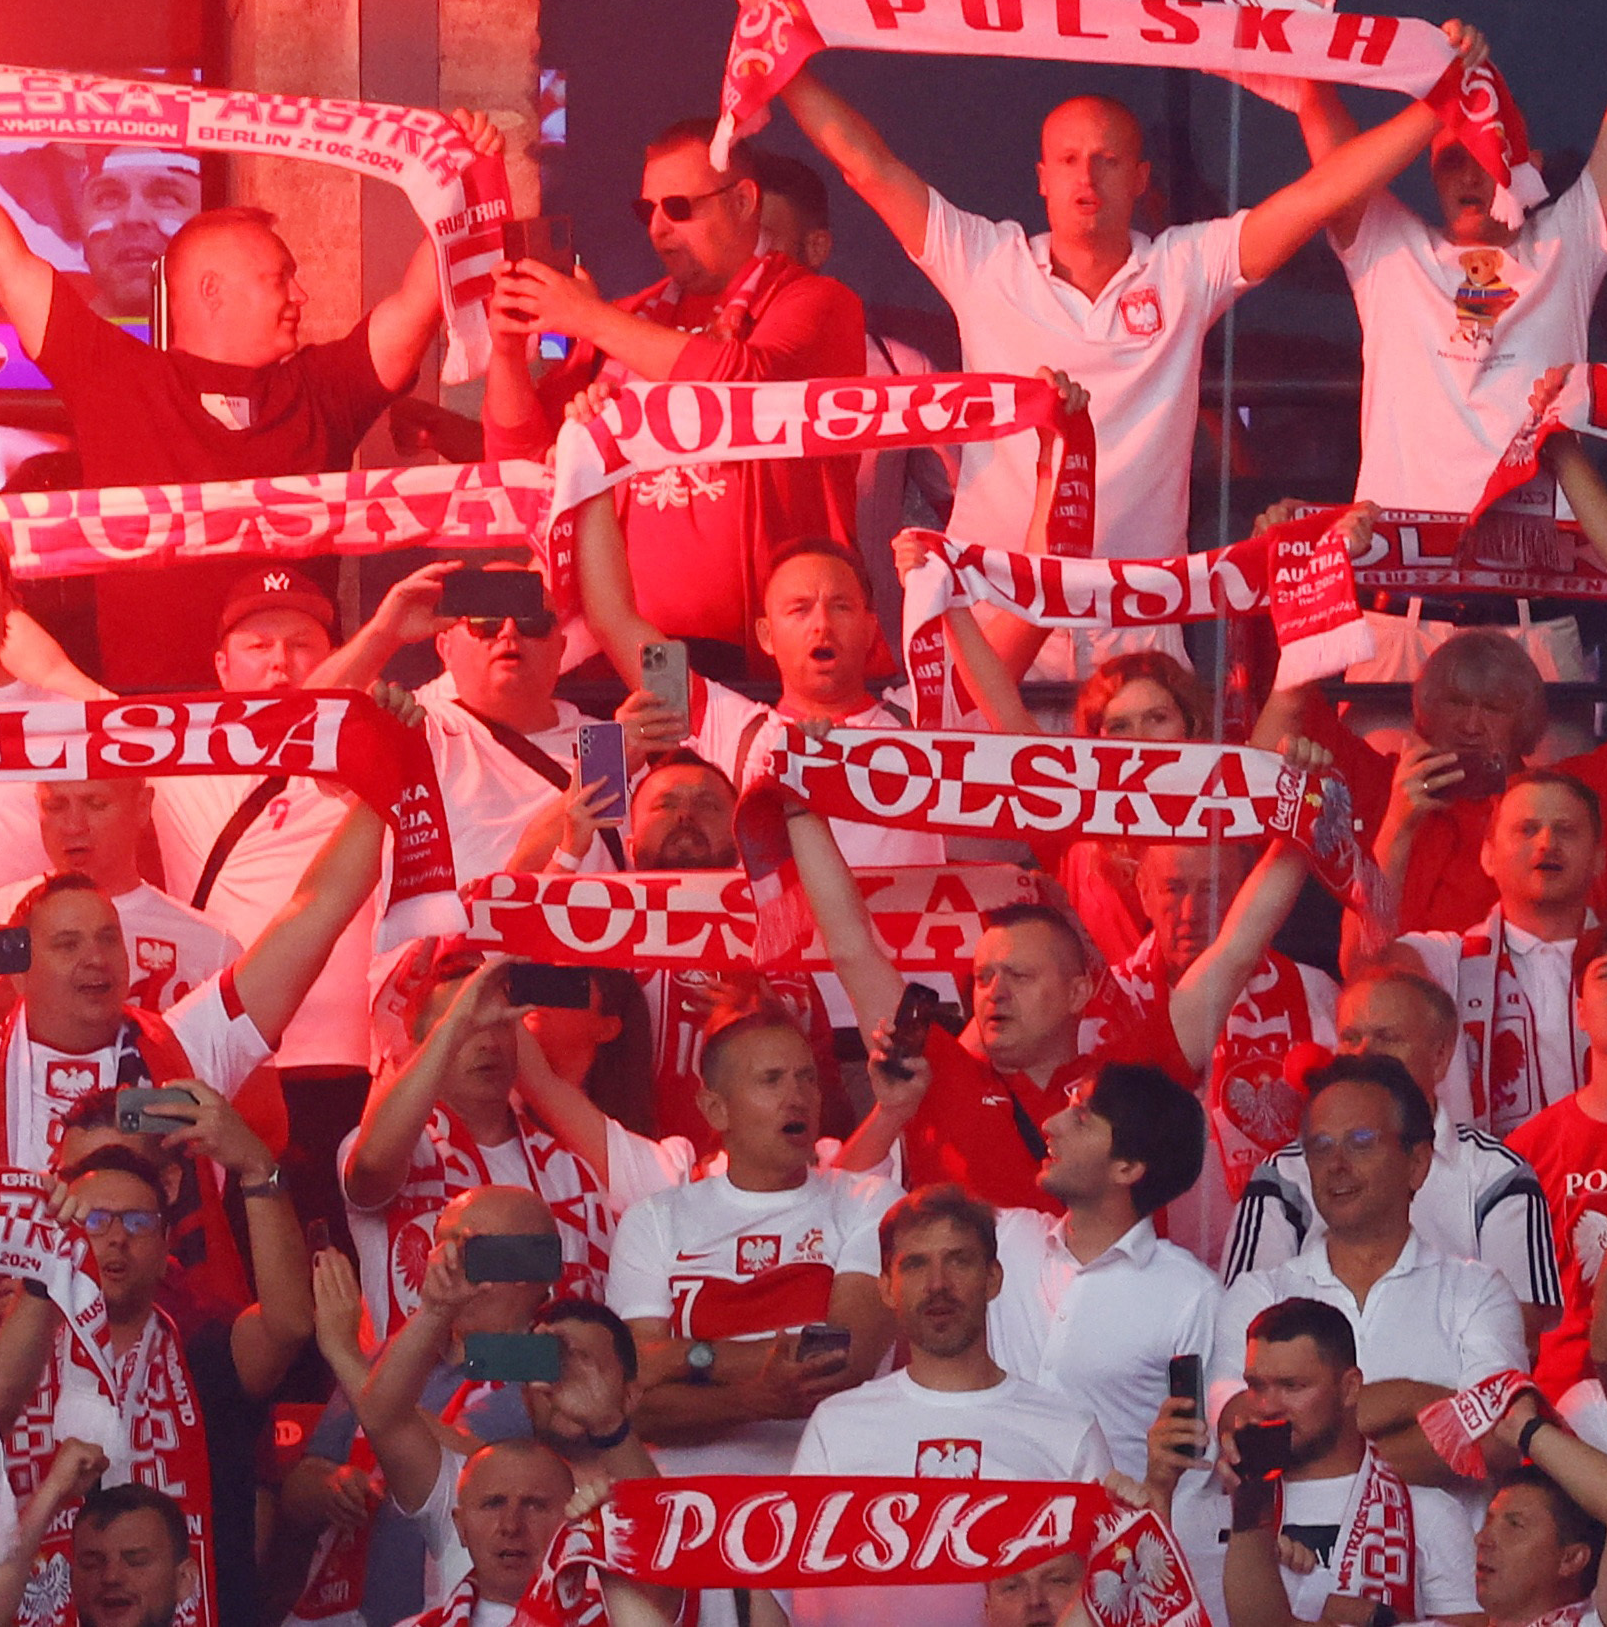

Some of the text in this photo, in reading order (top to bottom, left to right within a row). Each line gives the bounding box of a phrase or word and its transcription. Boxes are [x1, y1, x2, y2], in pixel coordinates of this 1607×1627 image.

[198, 126, 292, 148] BERLIN
[9, 461, 542, 578] POLSKA
[778, 729, 1268, 840] POLSKA
[650, 1488, 1084, 1576] POLSKA
